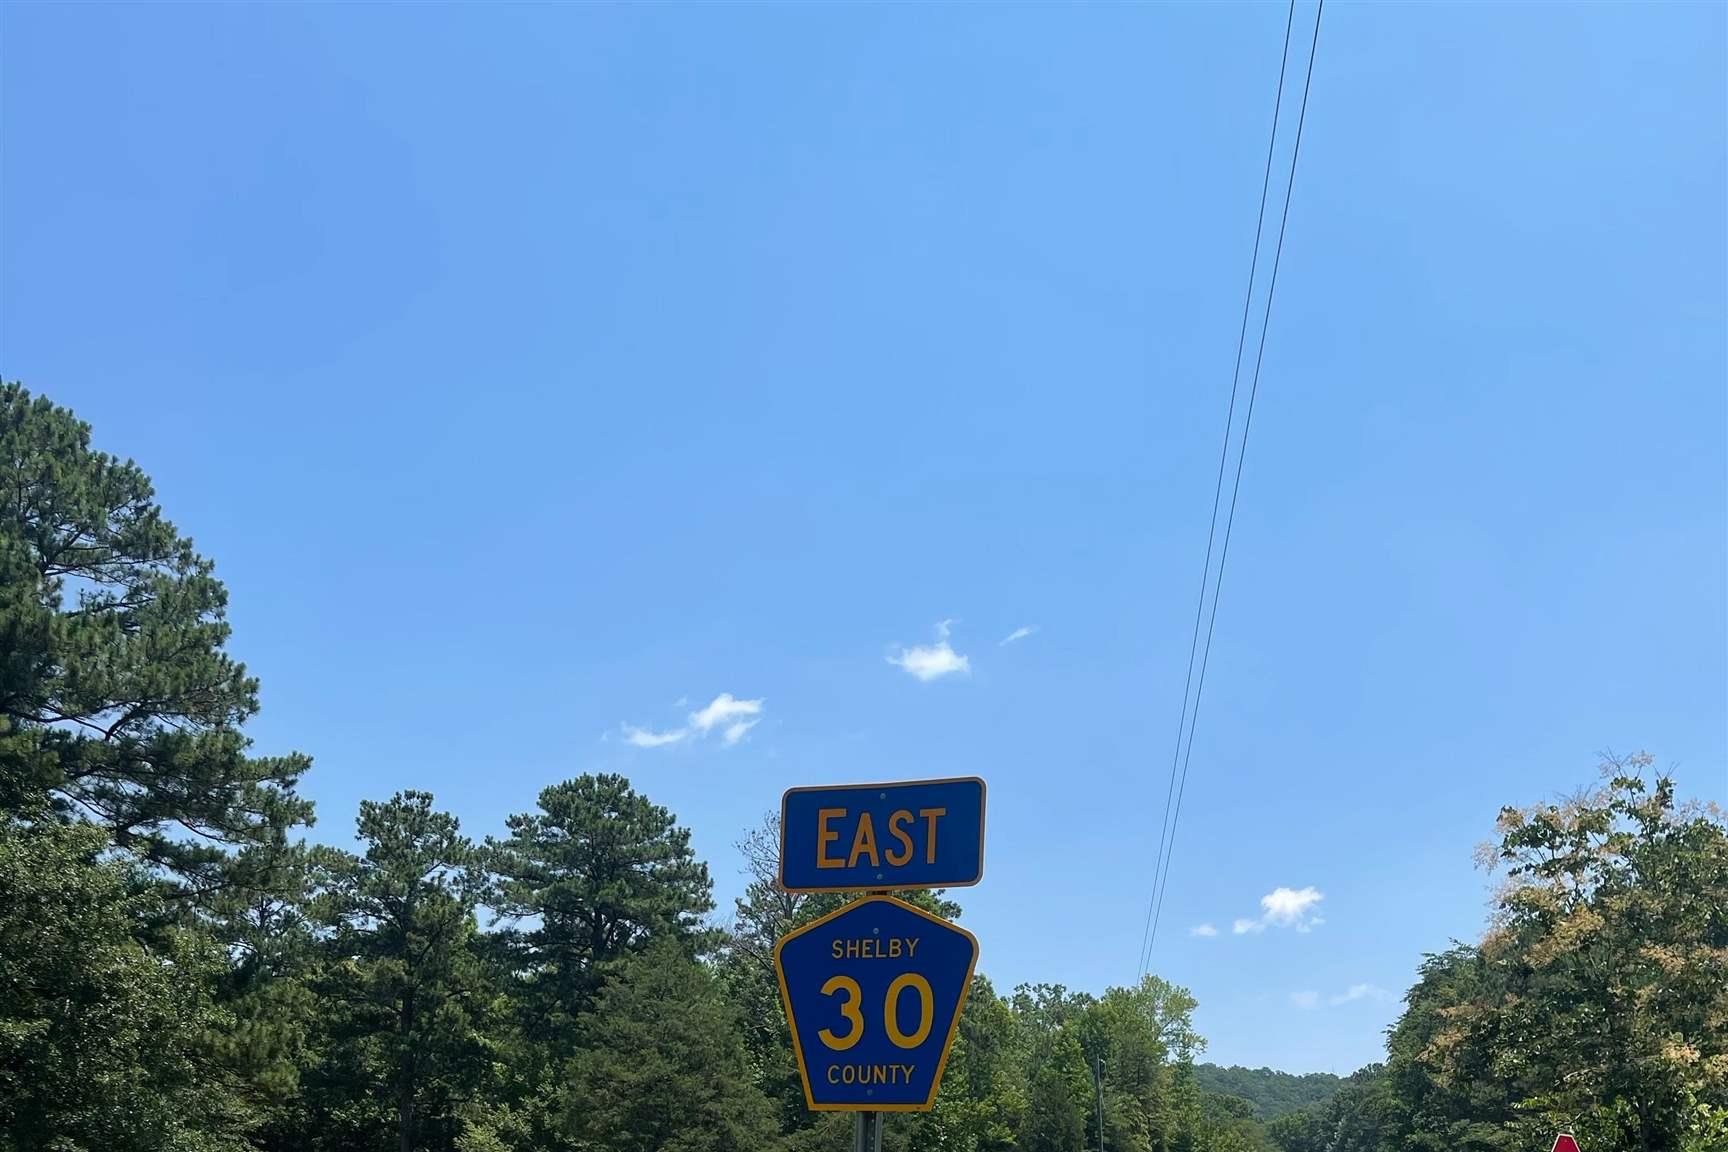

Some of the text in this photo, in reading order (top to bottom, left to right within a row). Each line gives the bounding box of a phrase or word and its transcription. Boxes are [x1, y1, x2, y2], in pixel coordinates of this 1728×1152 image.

[816, 807, 946, 868] EAST
[831, 938, 920, 959] SHELBY
[817, 972, 934, 1051] 30
[827, 1064, 915, 1085] COUNTY
